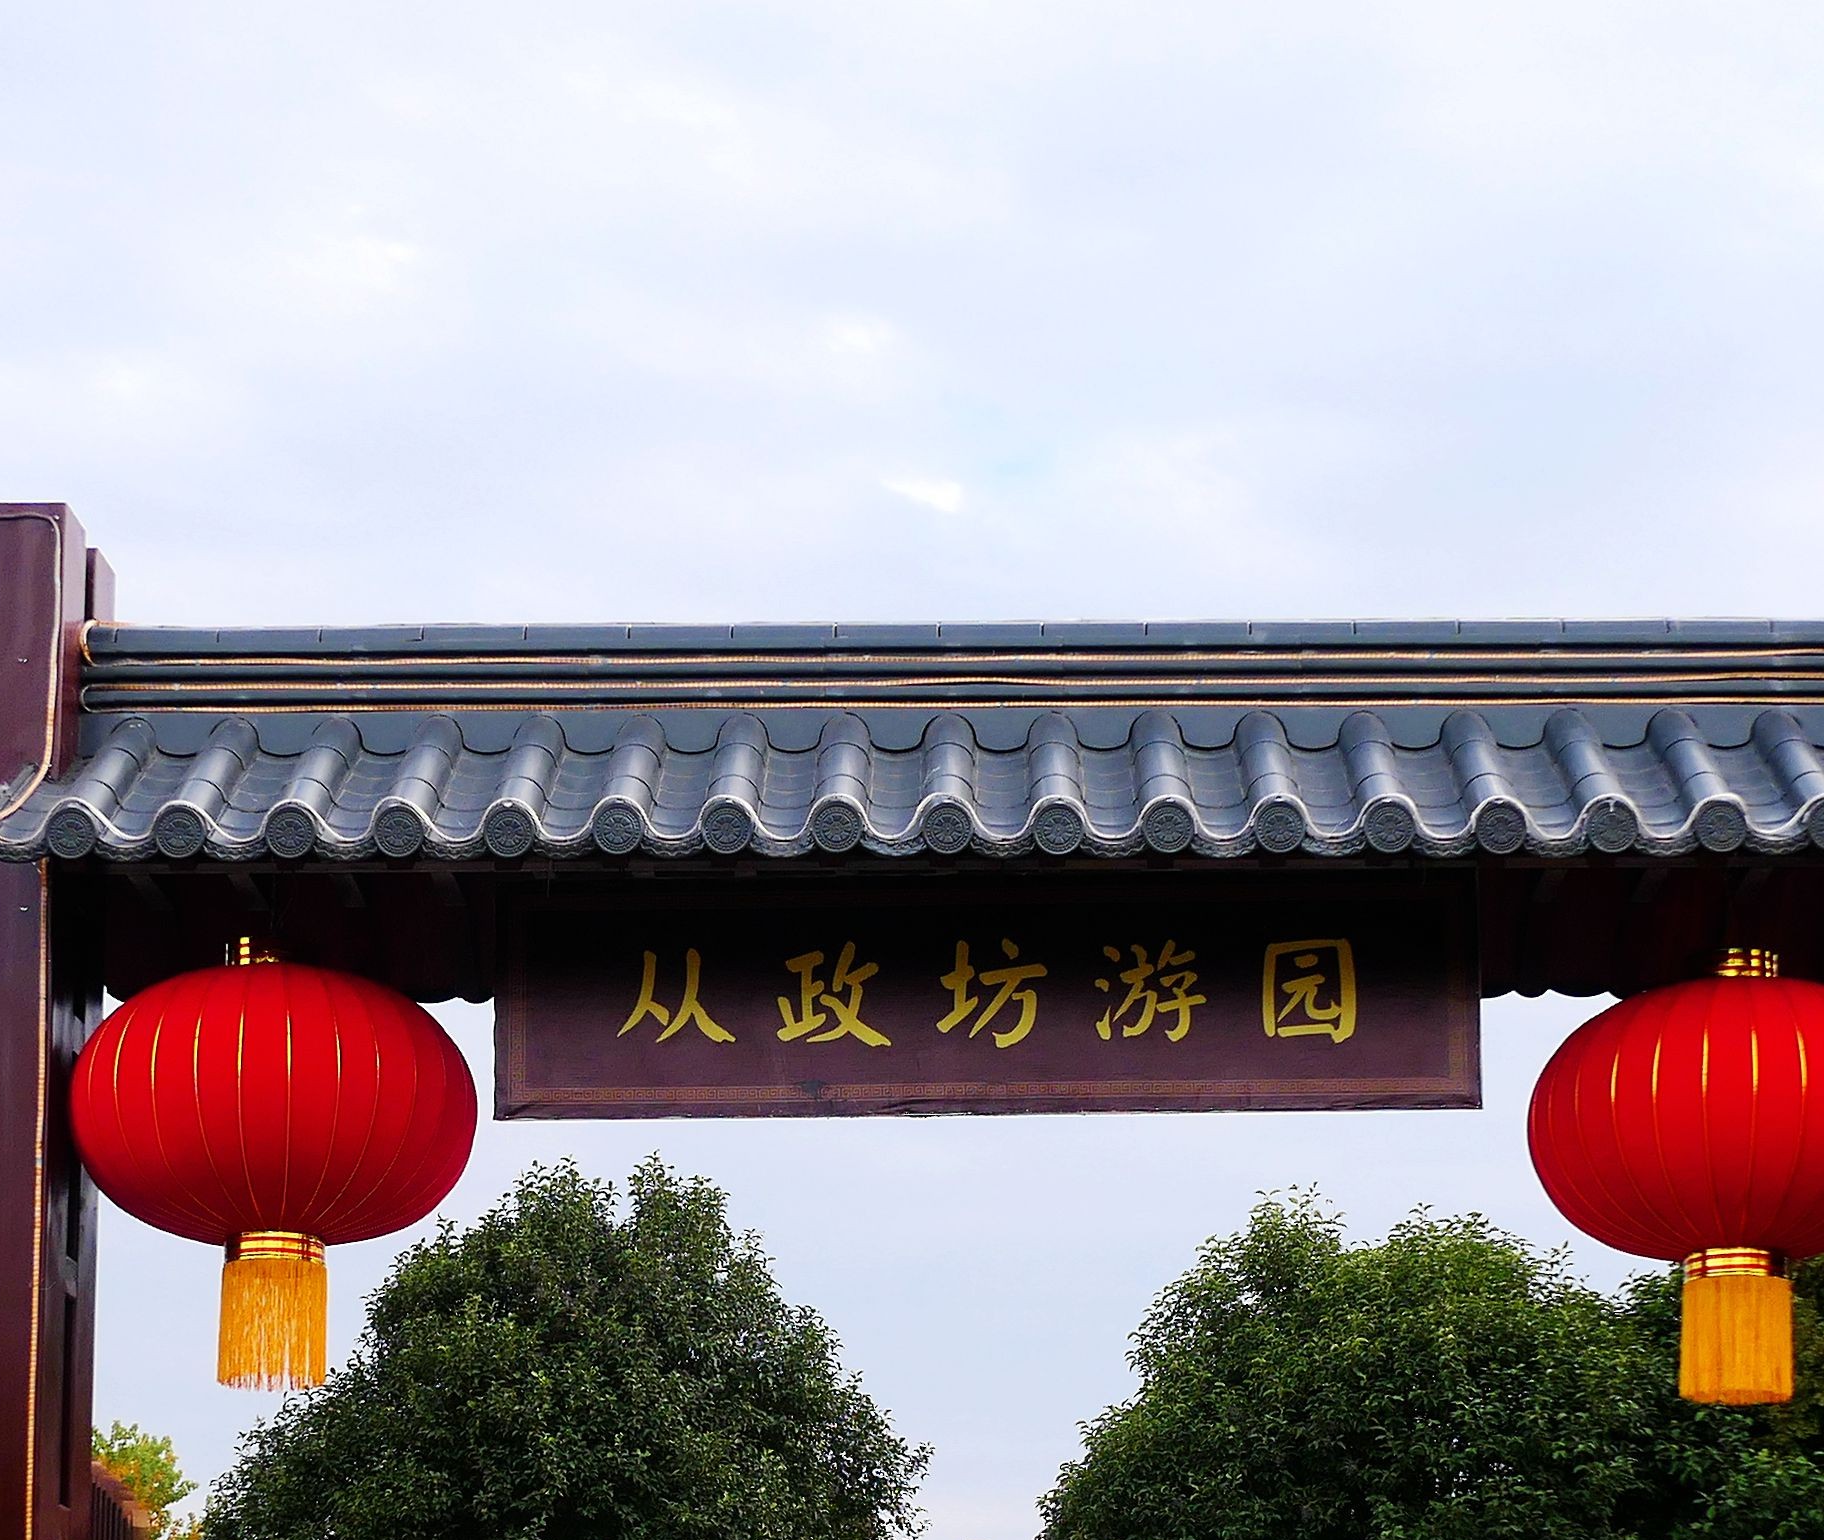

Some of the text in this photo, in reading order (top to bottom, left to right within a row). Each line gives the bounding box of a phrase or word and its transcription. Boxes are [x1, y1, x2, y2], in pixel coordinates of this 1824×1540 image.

[616, 937, 1358, 1049] 从政坊游园
